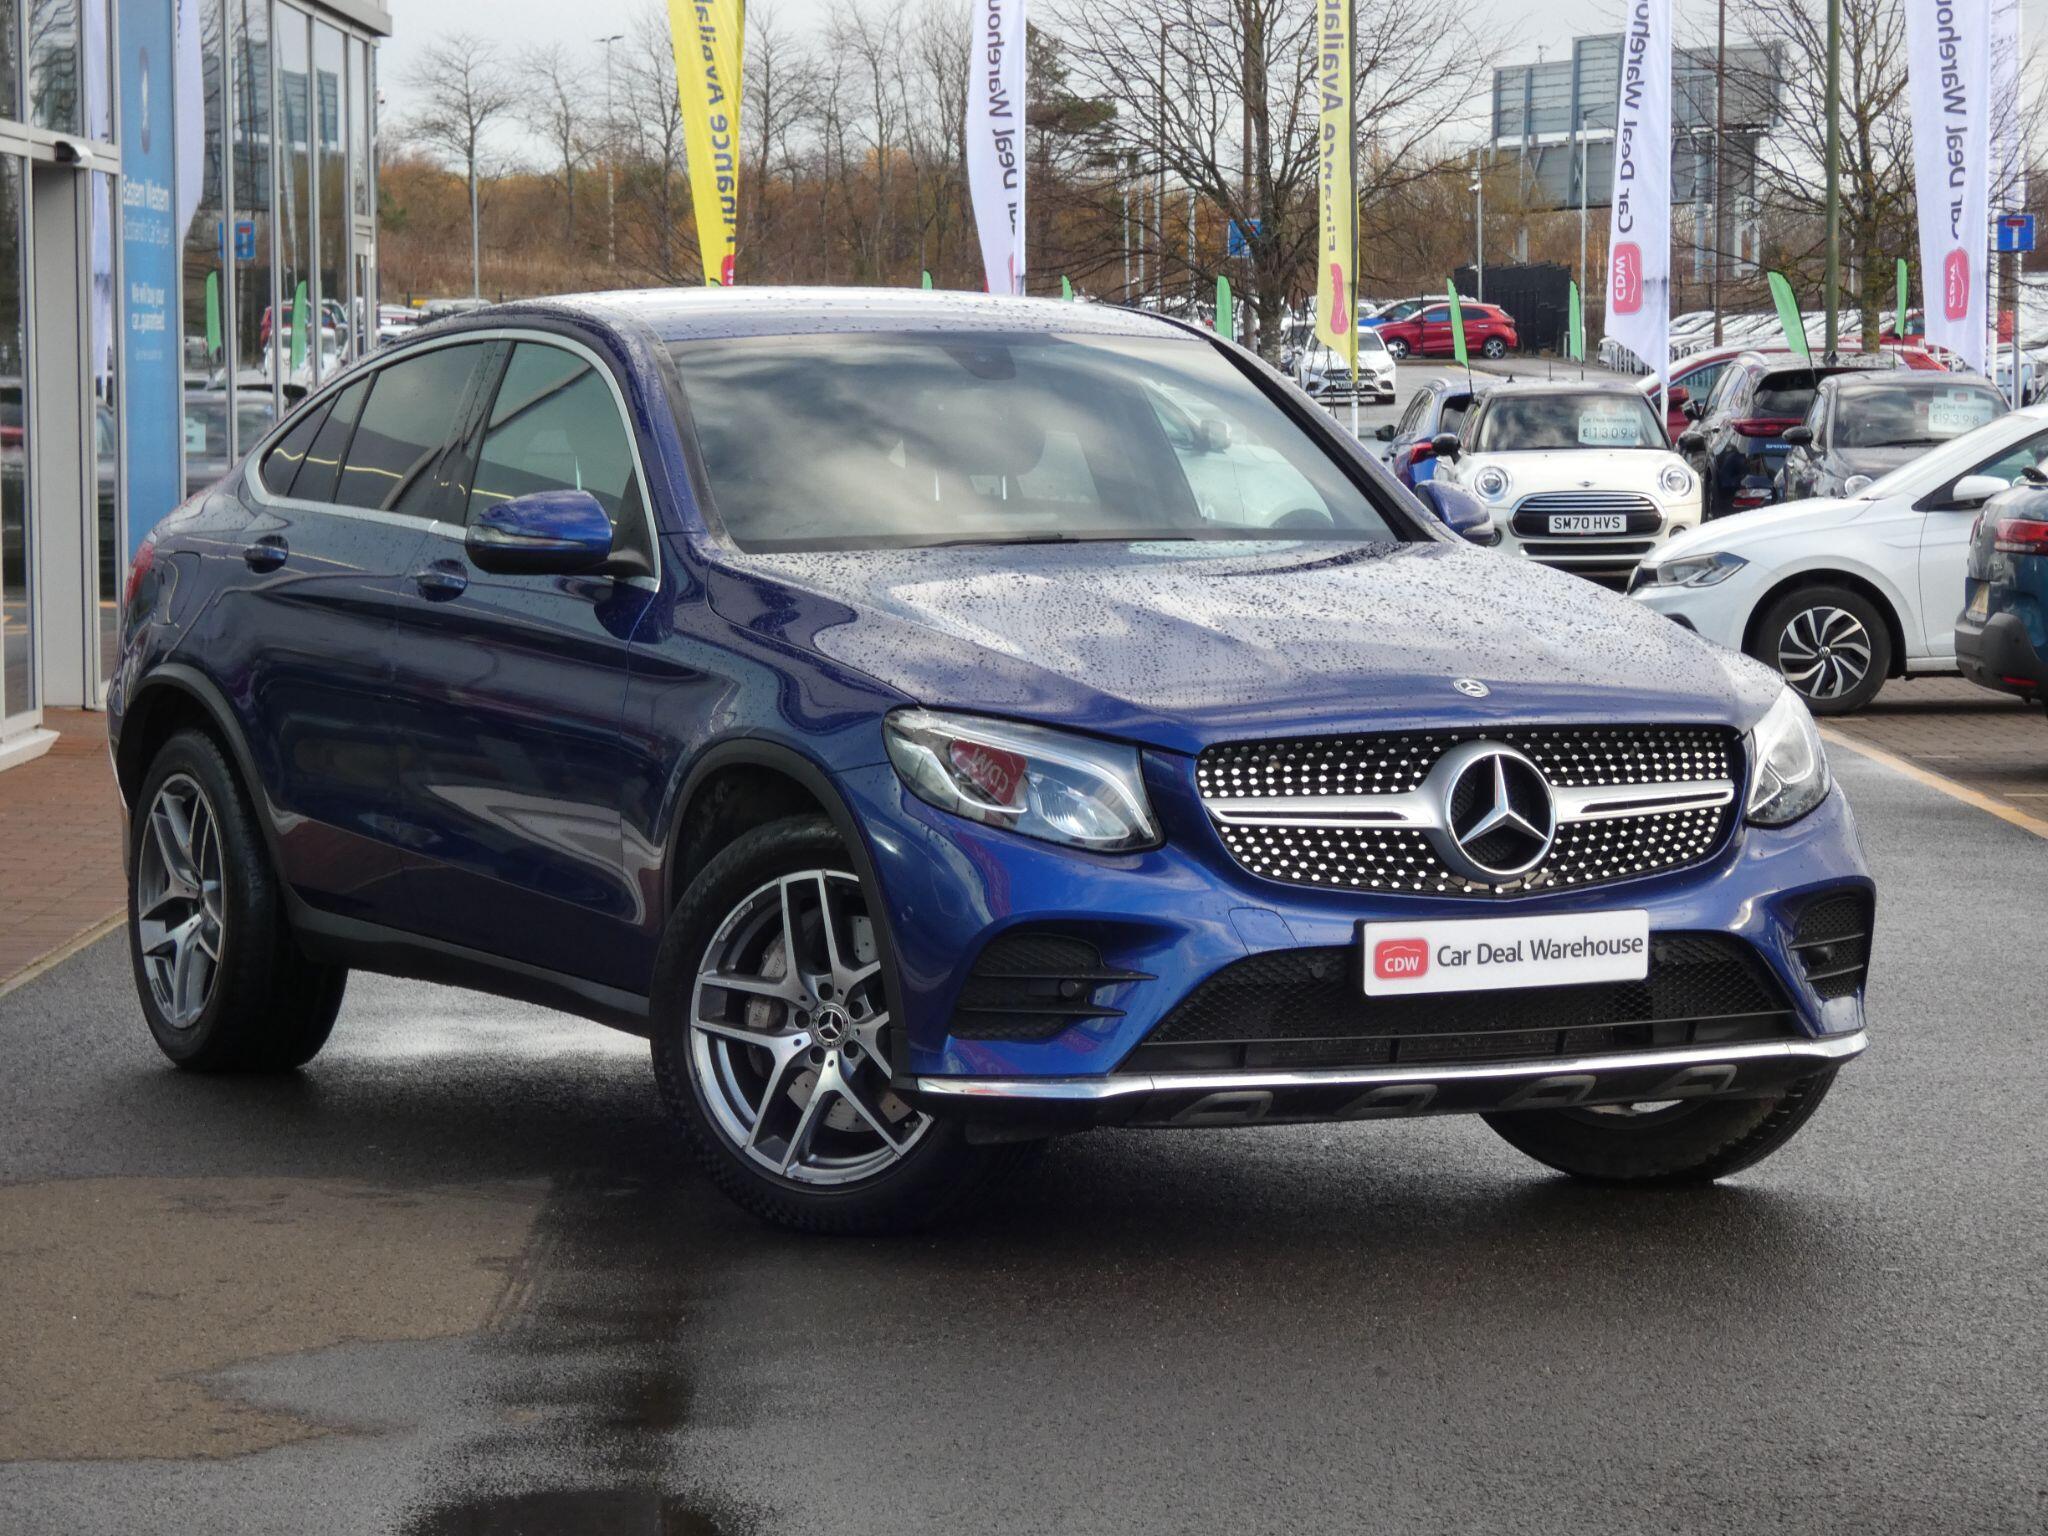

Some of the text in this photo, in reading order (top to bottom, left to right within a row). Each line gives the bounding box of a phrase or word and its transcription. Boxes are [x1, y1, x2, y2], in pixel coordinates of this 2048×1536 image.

[1554, 516, 1621, 530] SM70 HVS
[1437, 936, 1644, 968] Car Deal Warehouse
[1384, 955, 1420, 973] CDW
